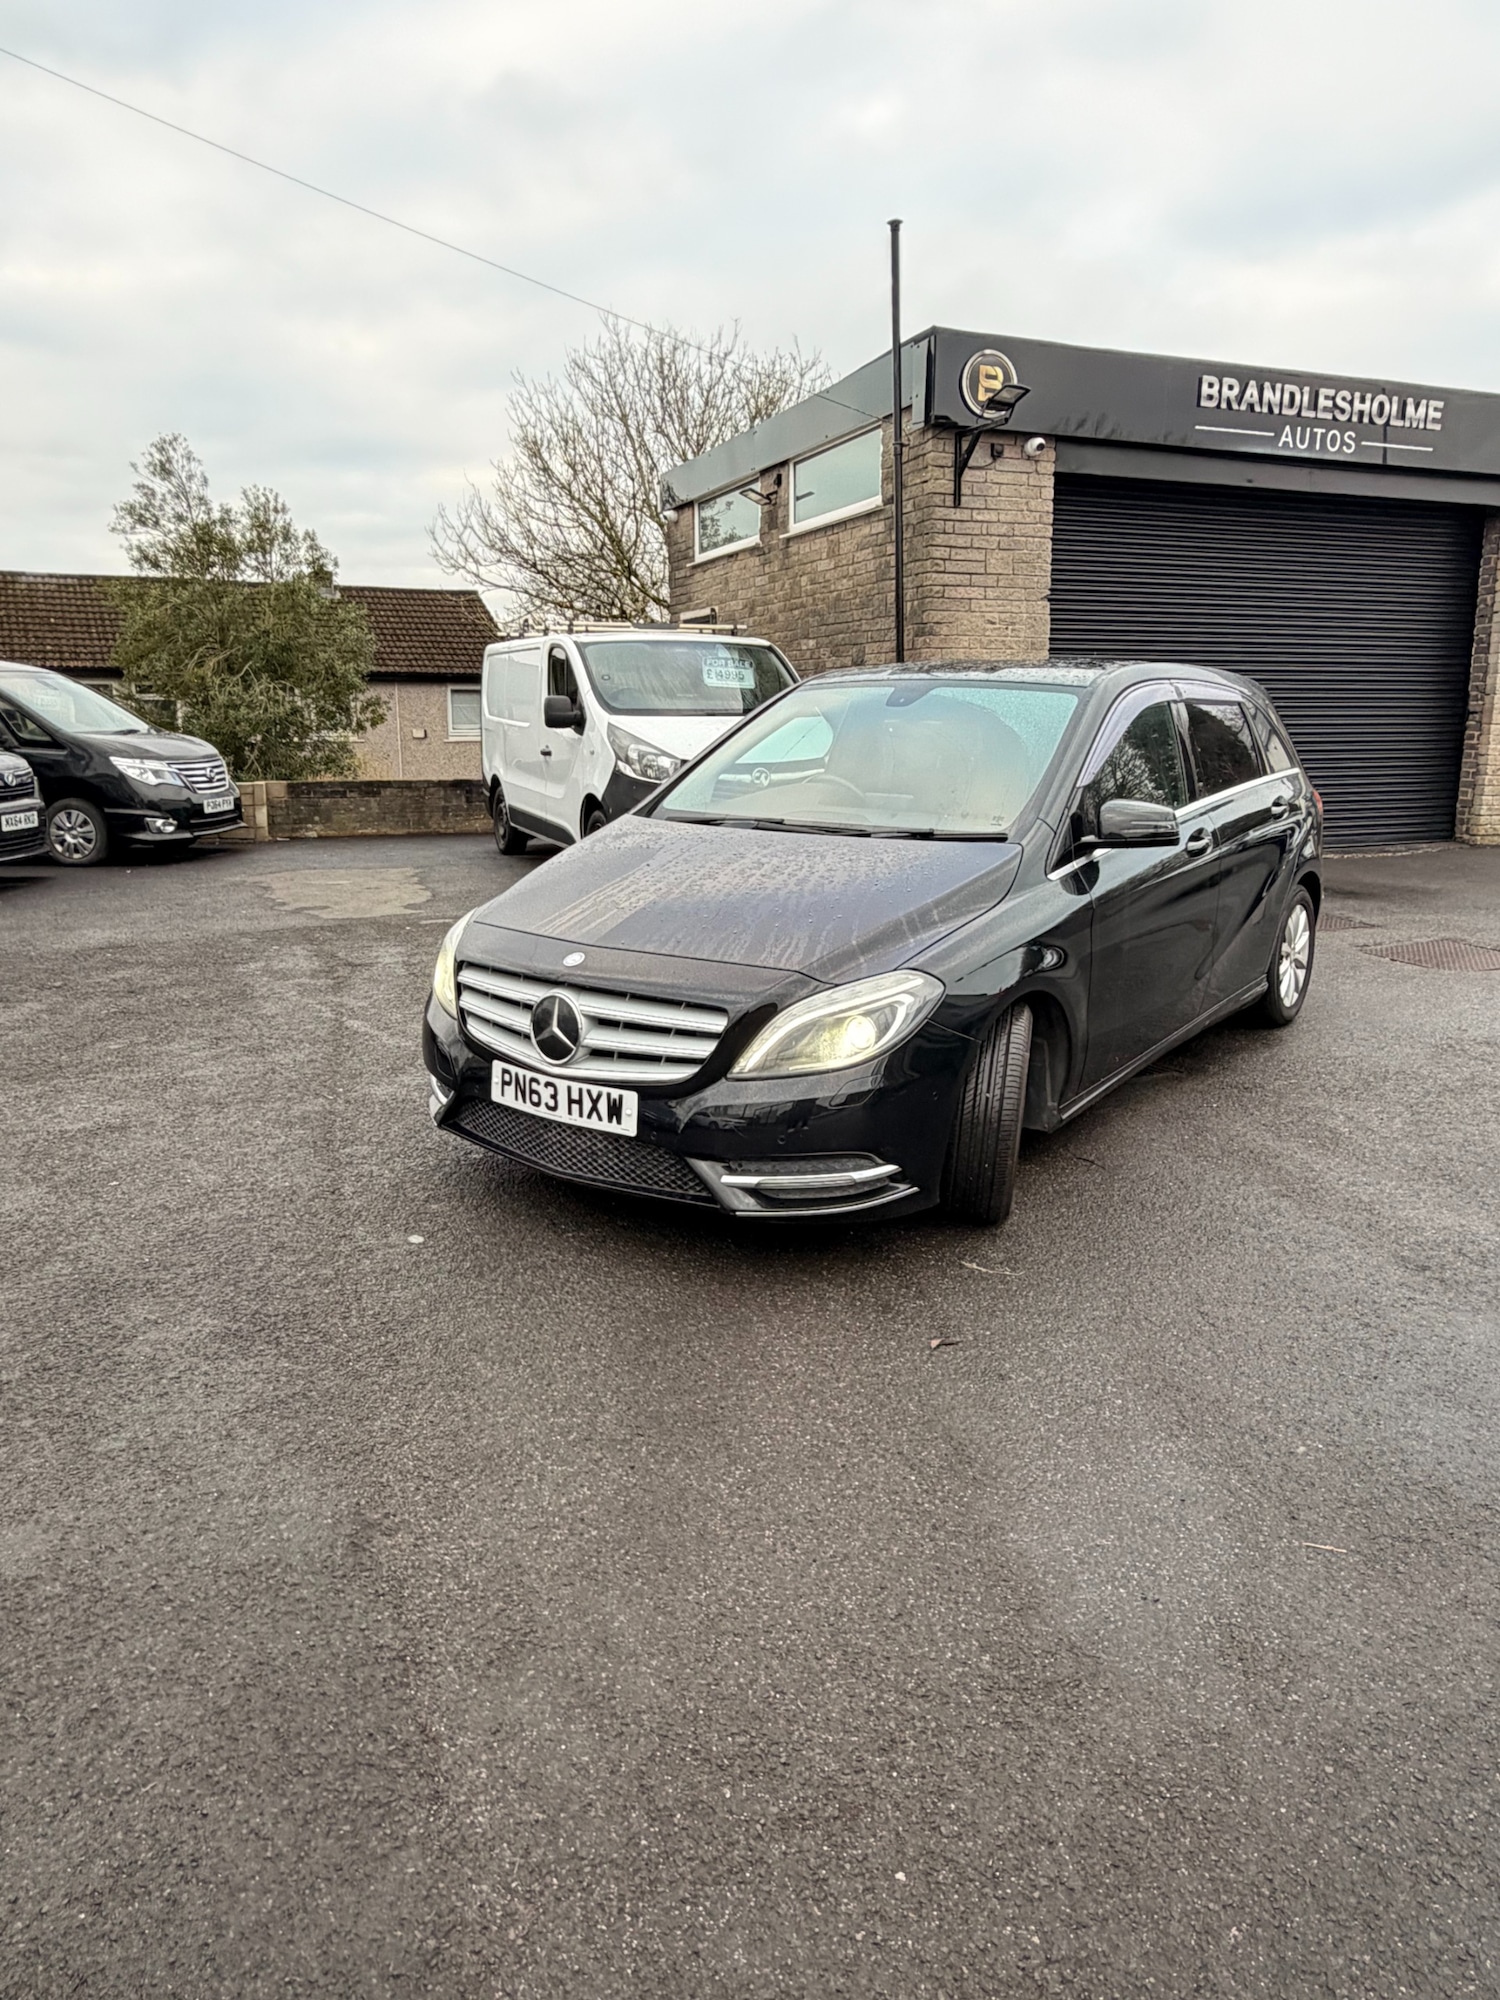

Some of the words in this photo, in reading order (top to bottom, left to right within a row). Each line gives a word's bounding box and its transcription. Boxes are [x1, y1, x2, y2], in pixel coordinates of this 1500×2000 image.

[1198, 374, 1445, 431] BRANDLESHOLME
[1277, 425, 1357, 454] AUTOS
[706, 658, 725, 667] FOR
[501, 1067, 559, 1112] PN63
[566, 1084, 624, 1126] HXW
